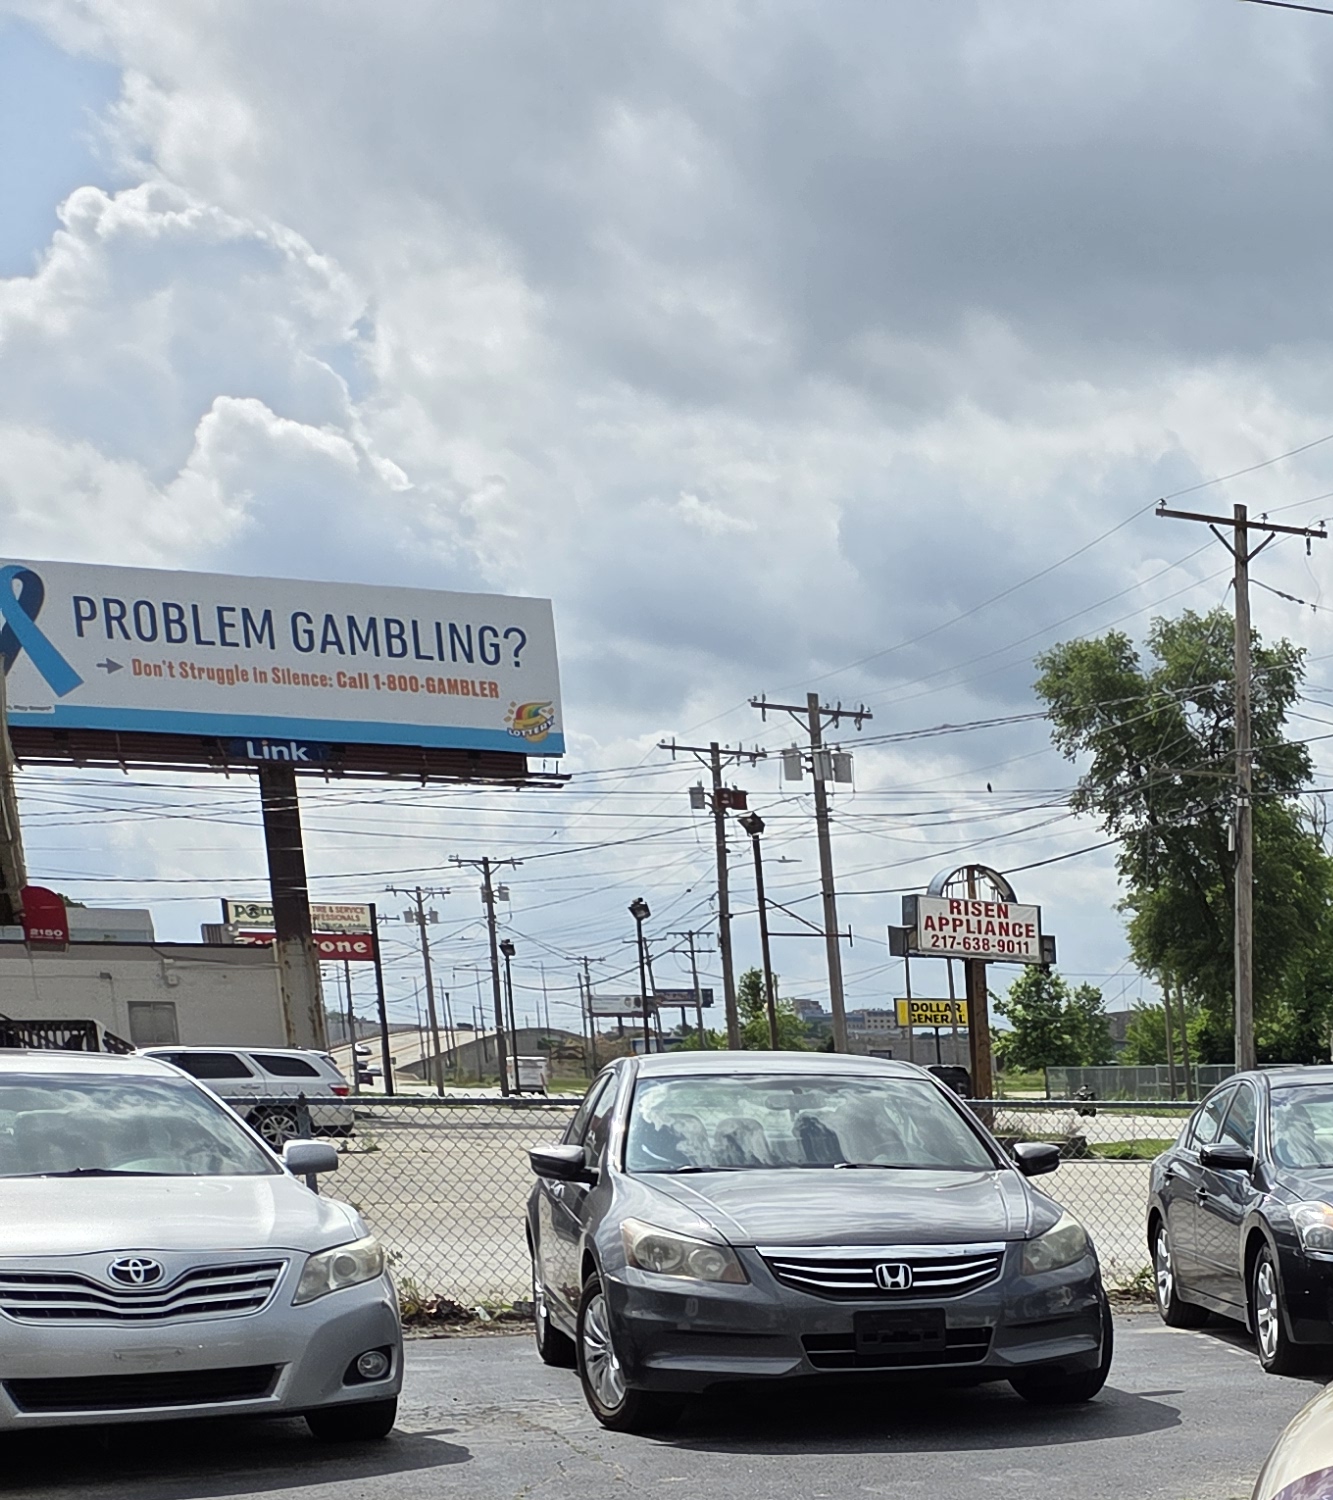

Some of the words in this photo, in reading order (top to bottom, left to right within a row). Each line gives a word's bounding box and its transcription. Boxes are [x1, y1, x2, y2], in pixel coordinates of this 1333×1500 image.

[72, 596, 277, 651] PROBLEM
[290, 611, 528, 668] GAMBLING?
[131, 658, 176, 679] Don't
[178, 660, 250, 687] Struggle
[252, 666, 269, 684] in
[271, 666, 334, 689] Silence:
[336, 671, 370, 690] Call
[372, 673, 500, 699] 1-800-GAMBLER
[508, 717, 554, 737] LOTTERY
[246, 740, 312, 762] Link
[949, 899, 1009, 919] RISEN
[924, 915, 1036, 938] APPLIANCE
[931, 934, 1029, 954] 217-638-9011
[911, 1002, 962, 1013] DOLLAR
[911, 1013, 966, 1024] GENERL
